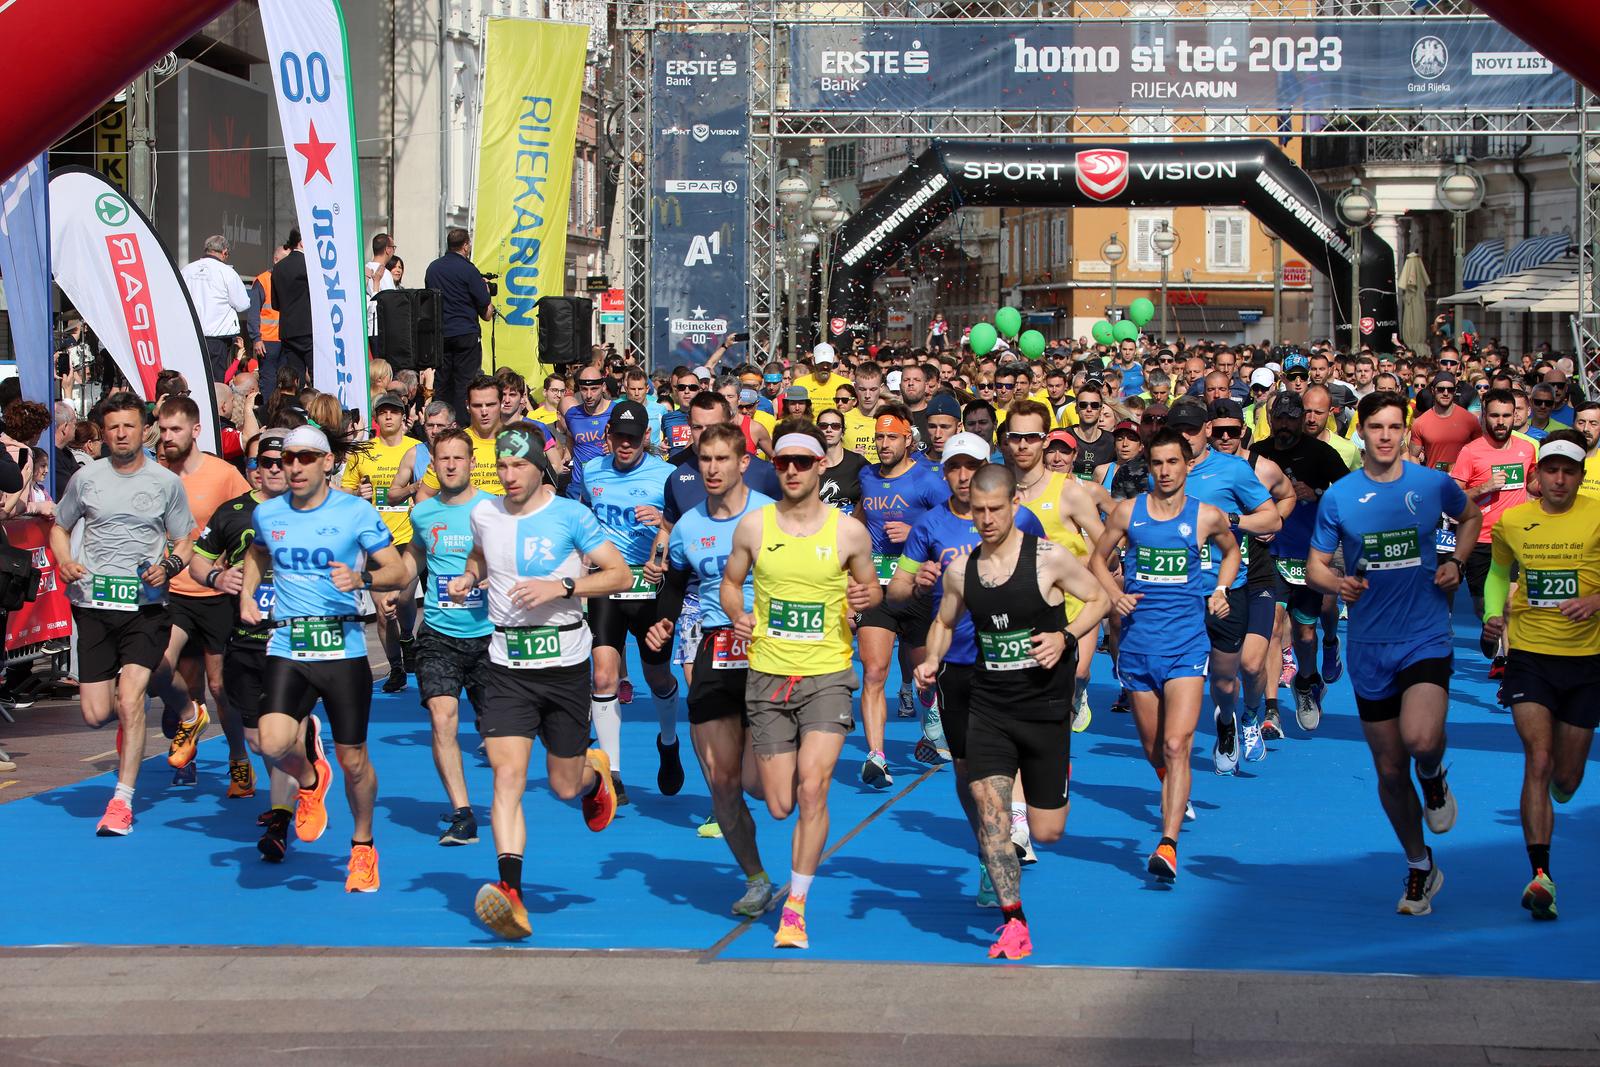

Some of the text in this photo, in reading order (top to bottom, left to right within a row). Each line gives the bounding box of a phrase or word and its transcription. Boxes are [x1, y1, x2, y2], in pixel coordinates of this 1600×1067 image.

[821, 50, 900, 74] ERSTE
[1014, 36, 1342, 73] homo si teć 2023
[666, 60, 718, 76] ERSTE
[1476, 57, 1548, 69] NOVI LIST
[666, 76, 692, 86] Bank
[820, 77, 860, 91] Bank
[1407, 83, 1451, 92] Grad Rijeka
[1131, 81, 1237, 99] RIJEKARUN
[101, 109, 124, 194] OTK
[963, 161, 1237, 181] SPORT VISION
[676, 181, 722, 190] SPAR
[505, 95, 552, 327] RIJEKARUN
[841, 172, 948, 267] WWW.SPORTVISION.HR
[683, 230, 720, 267] A1
[1283, 273, 1306, 281] KING
[674, 321, 724, 332] Heineken
[691, 333, 706, 345] 0.0
[679, 473, 695, 484] spin
[1511, 469, 1518, 481] 4
[1383, 542, 1410, 558] 887
[1522, 541, 1584, 550] Runners don't die!
[274, 547, 335, 571] CRO
[1154, 556, 1187, 572] 219
[110, 584, 138, 600] 103
[1543, 578, 1577, 595] 220
[787, 610, 822, 629] 316
[311, 630, 343, 647] 105
[524, 635, 559, 656] 120
[997, 638, 1033, 659] 295
